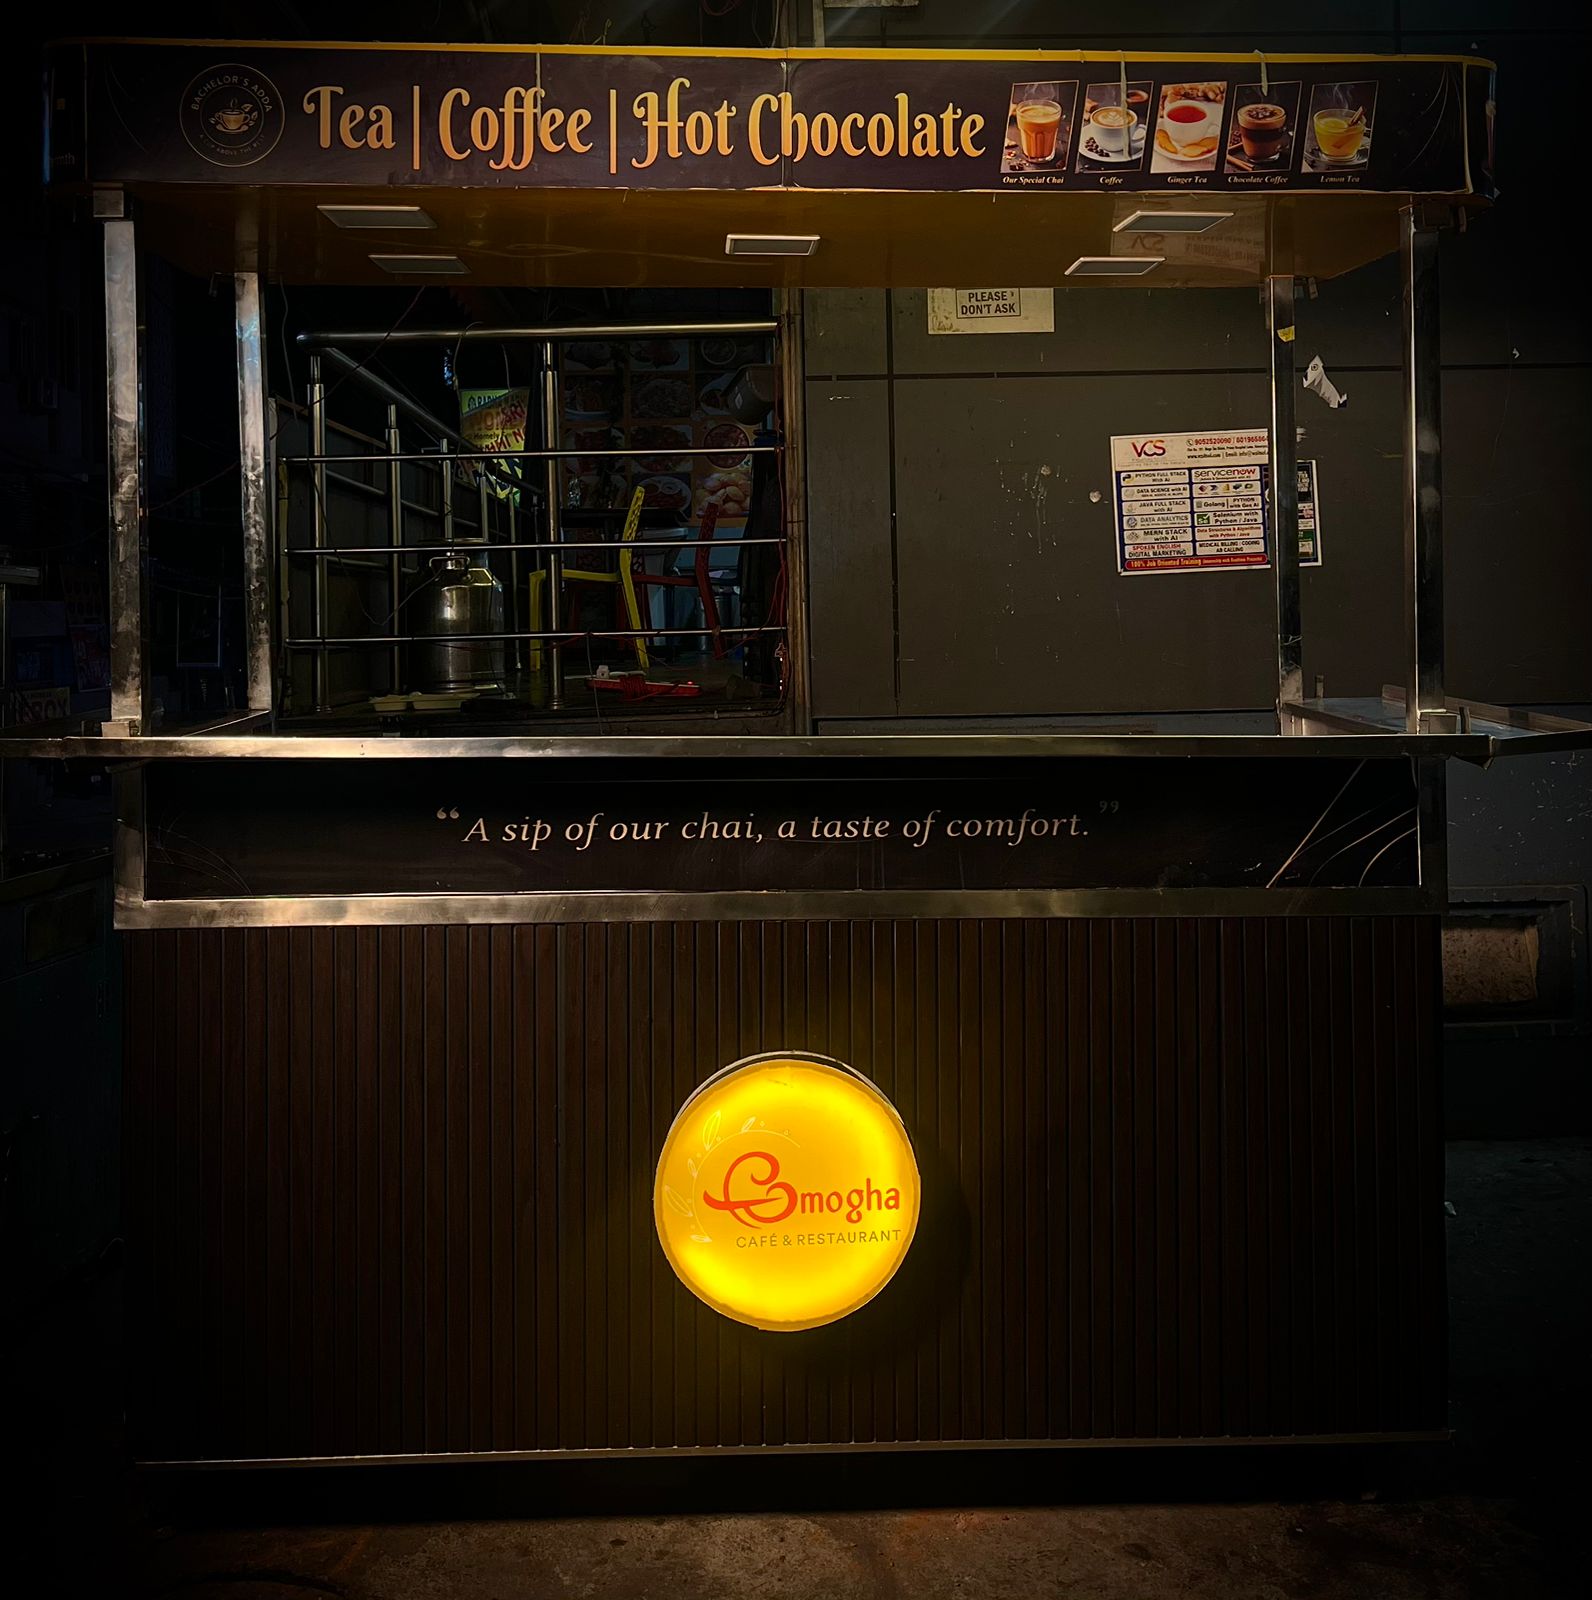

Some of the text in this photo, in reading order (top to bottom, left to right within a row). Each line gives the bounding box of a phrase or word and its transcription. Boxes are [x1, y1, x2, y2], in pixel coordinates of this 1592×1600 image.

[191, 75, 273, 113] BACHELOR'S ADDA
[302, 85, 397, 149] Tea
[438, 86, 593, 171] Coffee
[630, 76, 737, 169] Hot
[748, 92, 986, 166] Chocolate
[1002, 175, 1064, 186] Our Special Chai
[1099, 175, 1124, 186] Coffee
[1167, 175, 1208, 186] Ginger Tea
[1227, 175, 1289, 185] Chocolate Coffee
[1320, 175, 1361, 184] Lemon Tea
[968, 291, 1008, 302] PLEASE
[961, 303, 1016, 315] DON'T ASK
[1131, 440, 1166, 457] VCS
[1194, 468, 1256, 478] servicenow
[1130, 560, 1145, 568] 100%
[1146, 560, 1157, 568] Job
[1157, 558, 1179, 567] Oriented
[1180, 557, 1202, 567] Training
[501, 815, 552, 851] sip
[564, 812, 605, 851] of
[608, 821, 670, 841] our
[680, 811, 764, 844] chai,
[777, 819, 797, 839] a
[811, 815, 891, 839] taste
[902, 808, 942, 848] of
[736, 1229, 902, 1249] CAFÉ & RESTAURANT
